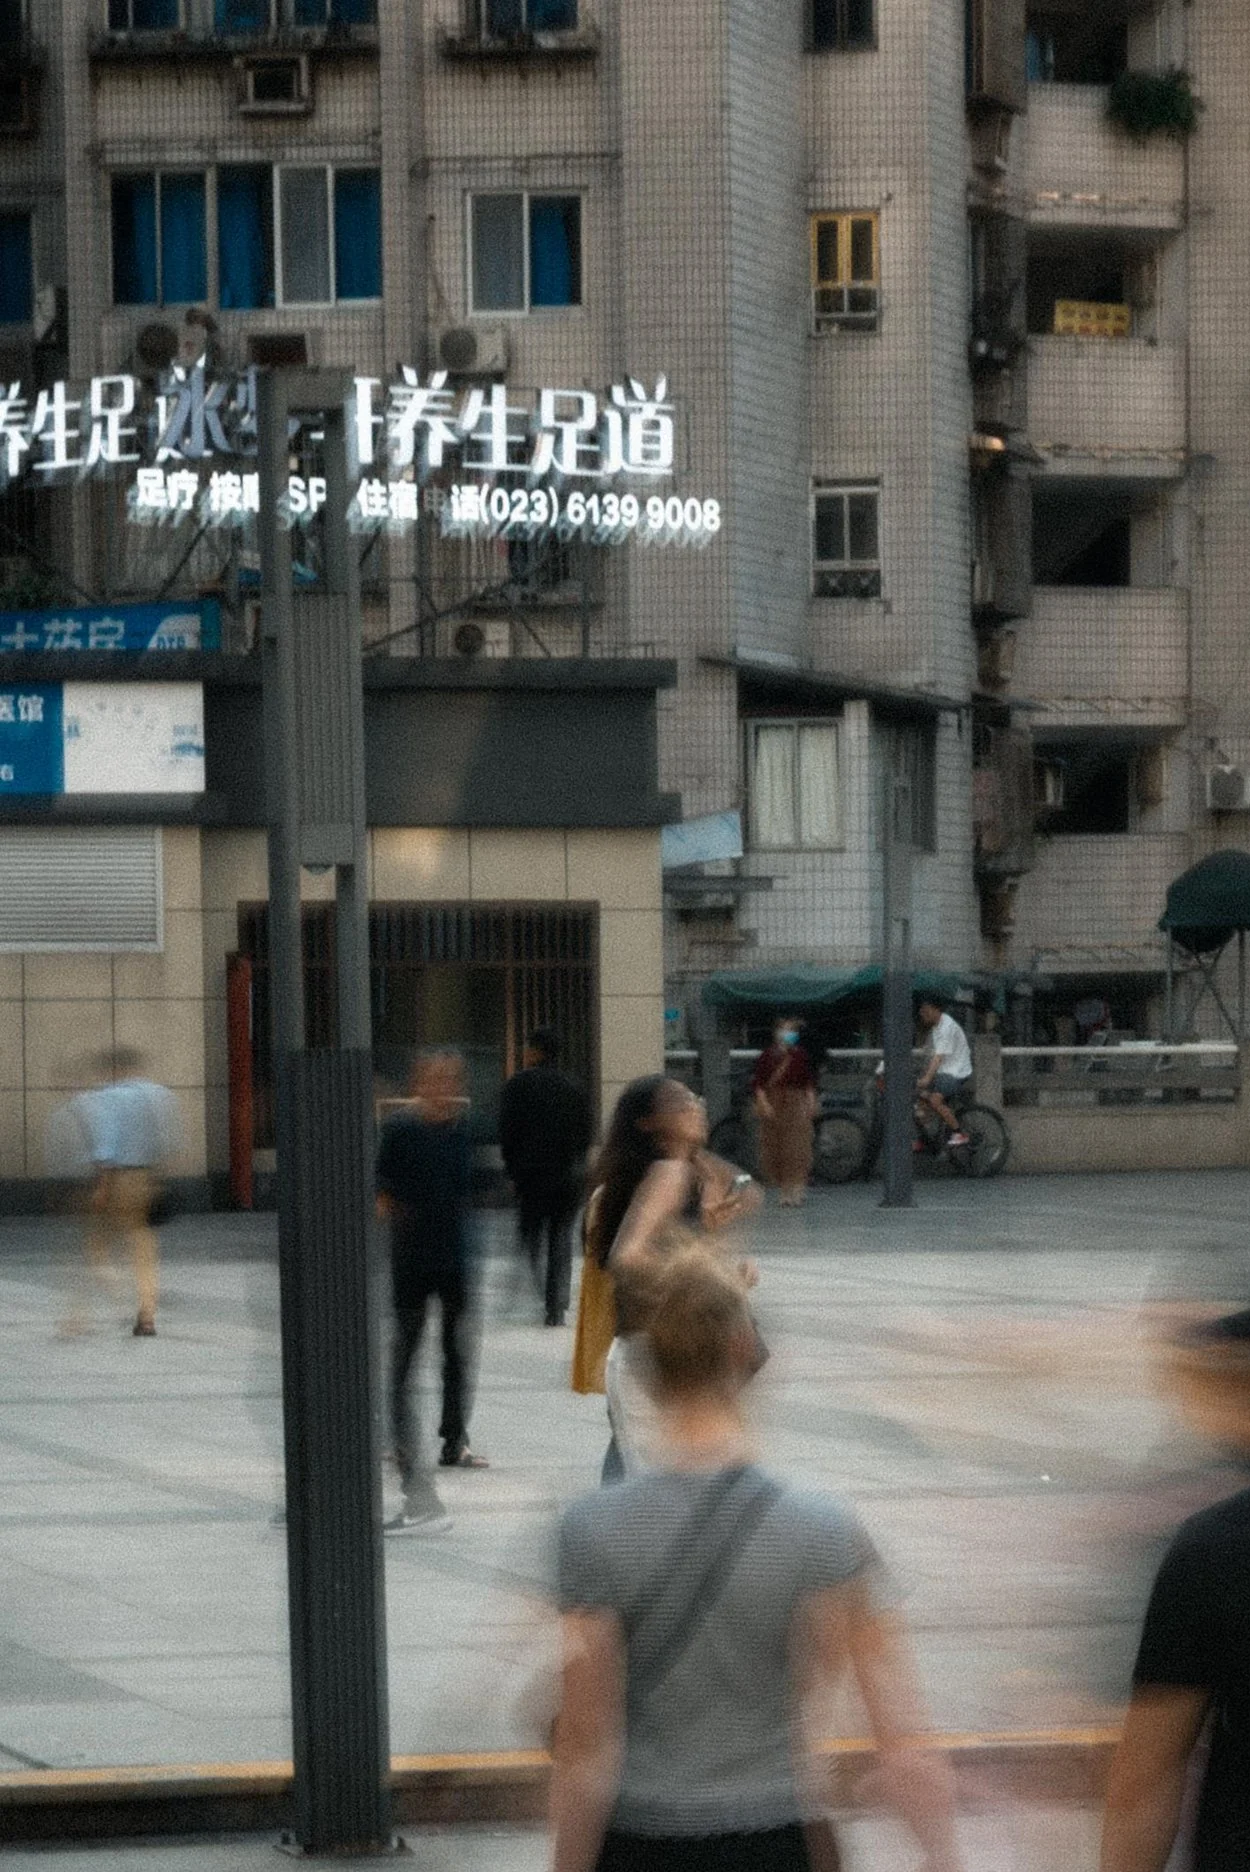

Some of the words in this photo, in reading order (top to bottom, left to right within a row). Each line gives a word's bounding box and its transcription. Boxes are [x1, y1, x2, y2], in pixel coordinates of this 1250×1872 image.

[288, 477, 327, 514] SP
[566, 495, 640, 529] 6139
[647, 499, 721, 533] 9008
